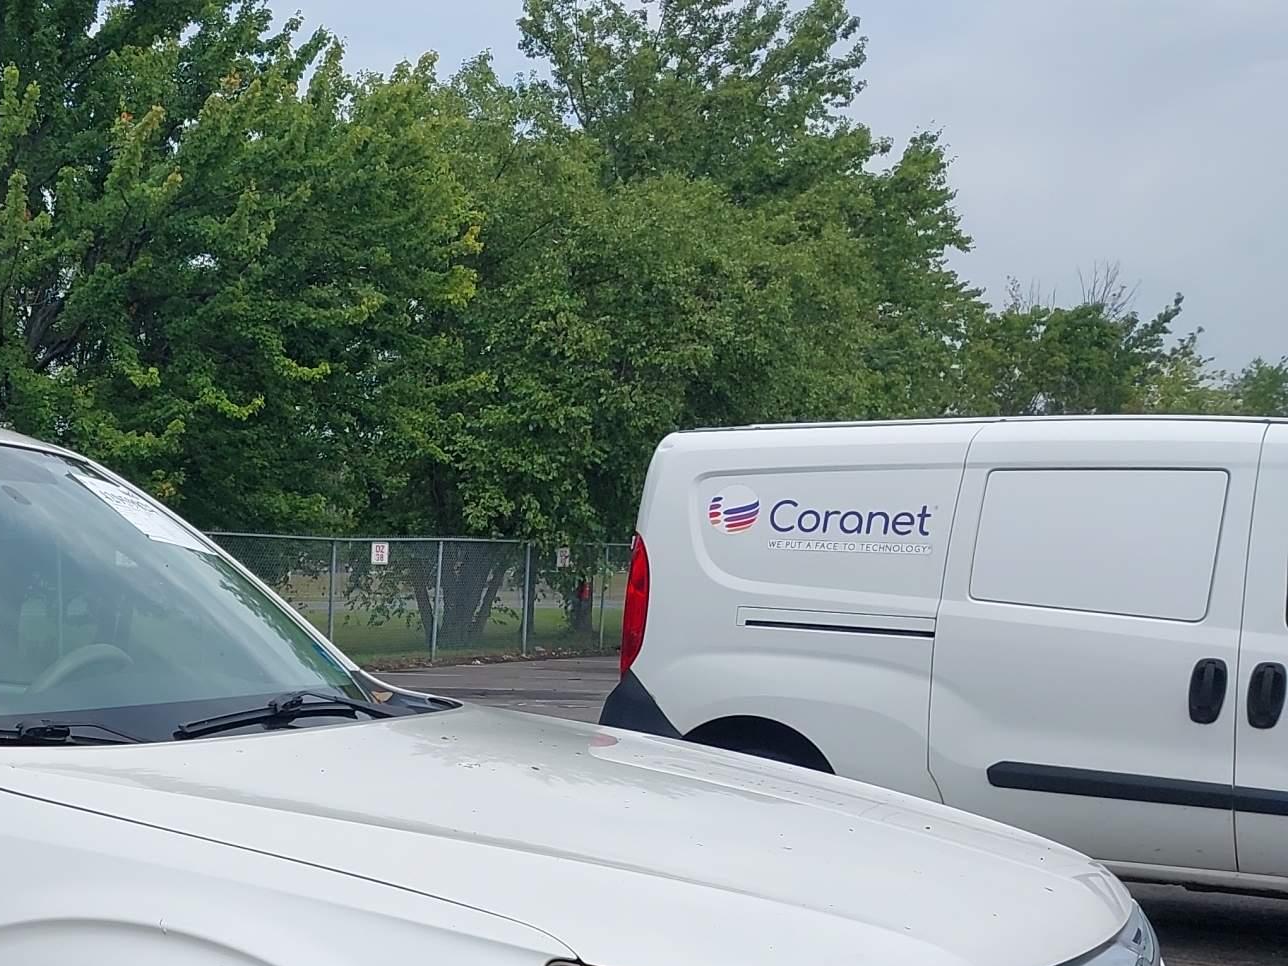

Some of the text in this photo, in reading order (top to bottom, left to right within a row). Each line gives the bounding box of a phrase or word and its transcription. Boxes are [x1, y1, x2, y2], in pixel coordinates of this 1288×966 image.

[769, 499, 932, 536] Coranet
[768, 540, 782, 549] WE
[785, 541, 803, 549] PUT
[805, 541, 812, 550] A
[814, 541, 839, 550] FACE
[842, 542, 856, 551] TO
